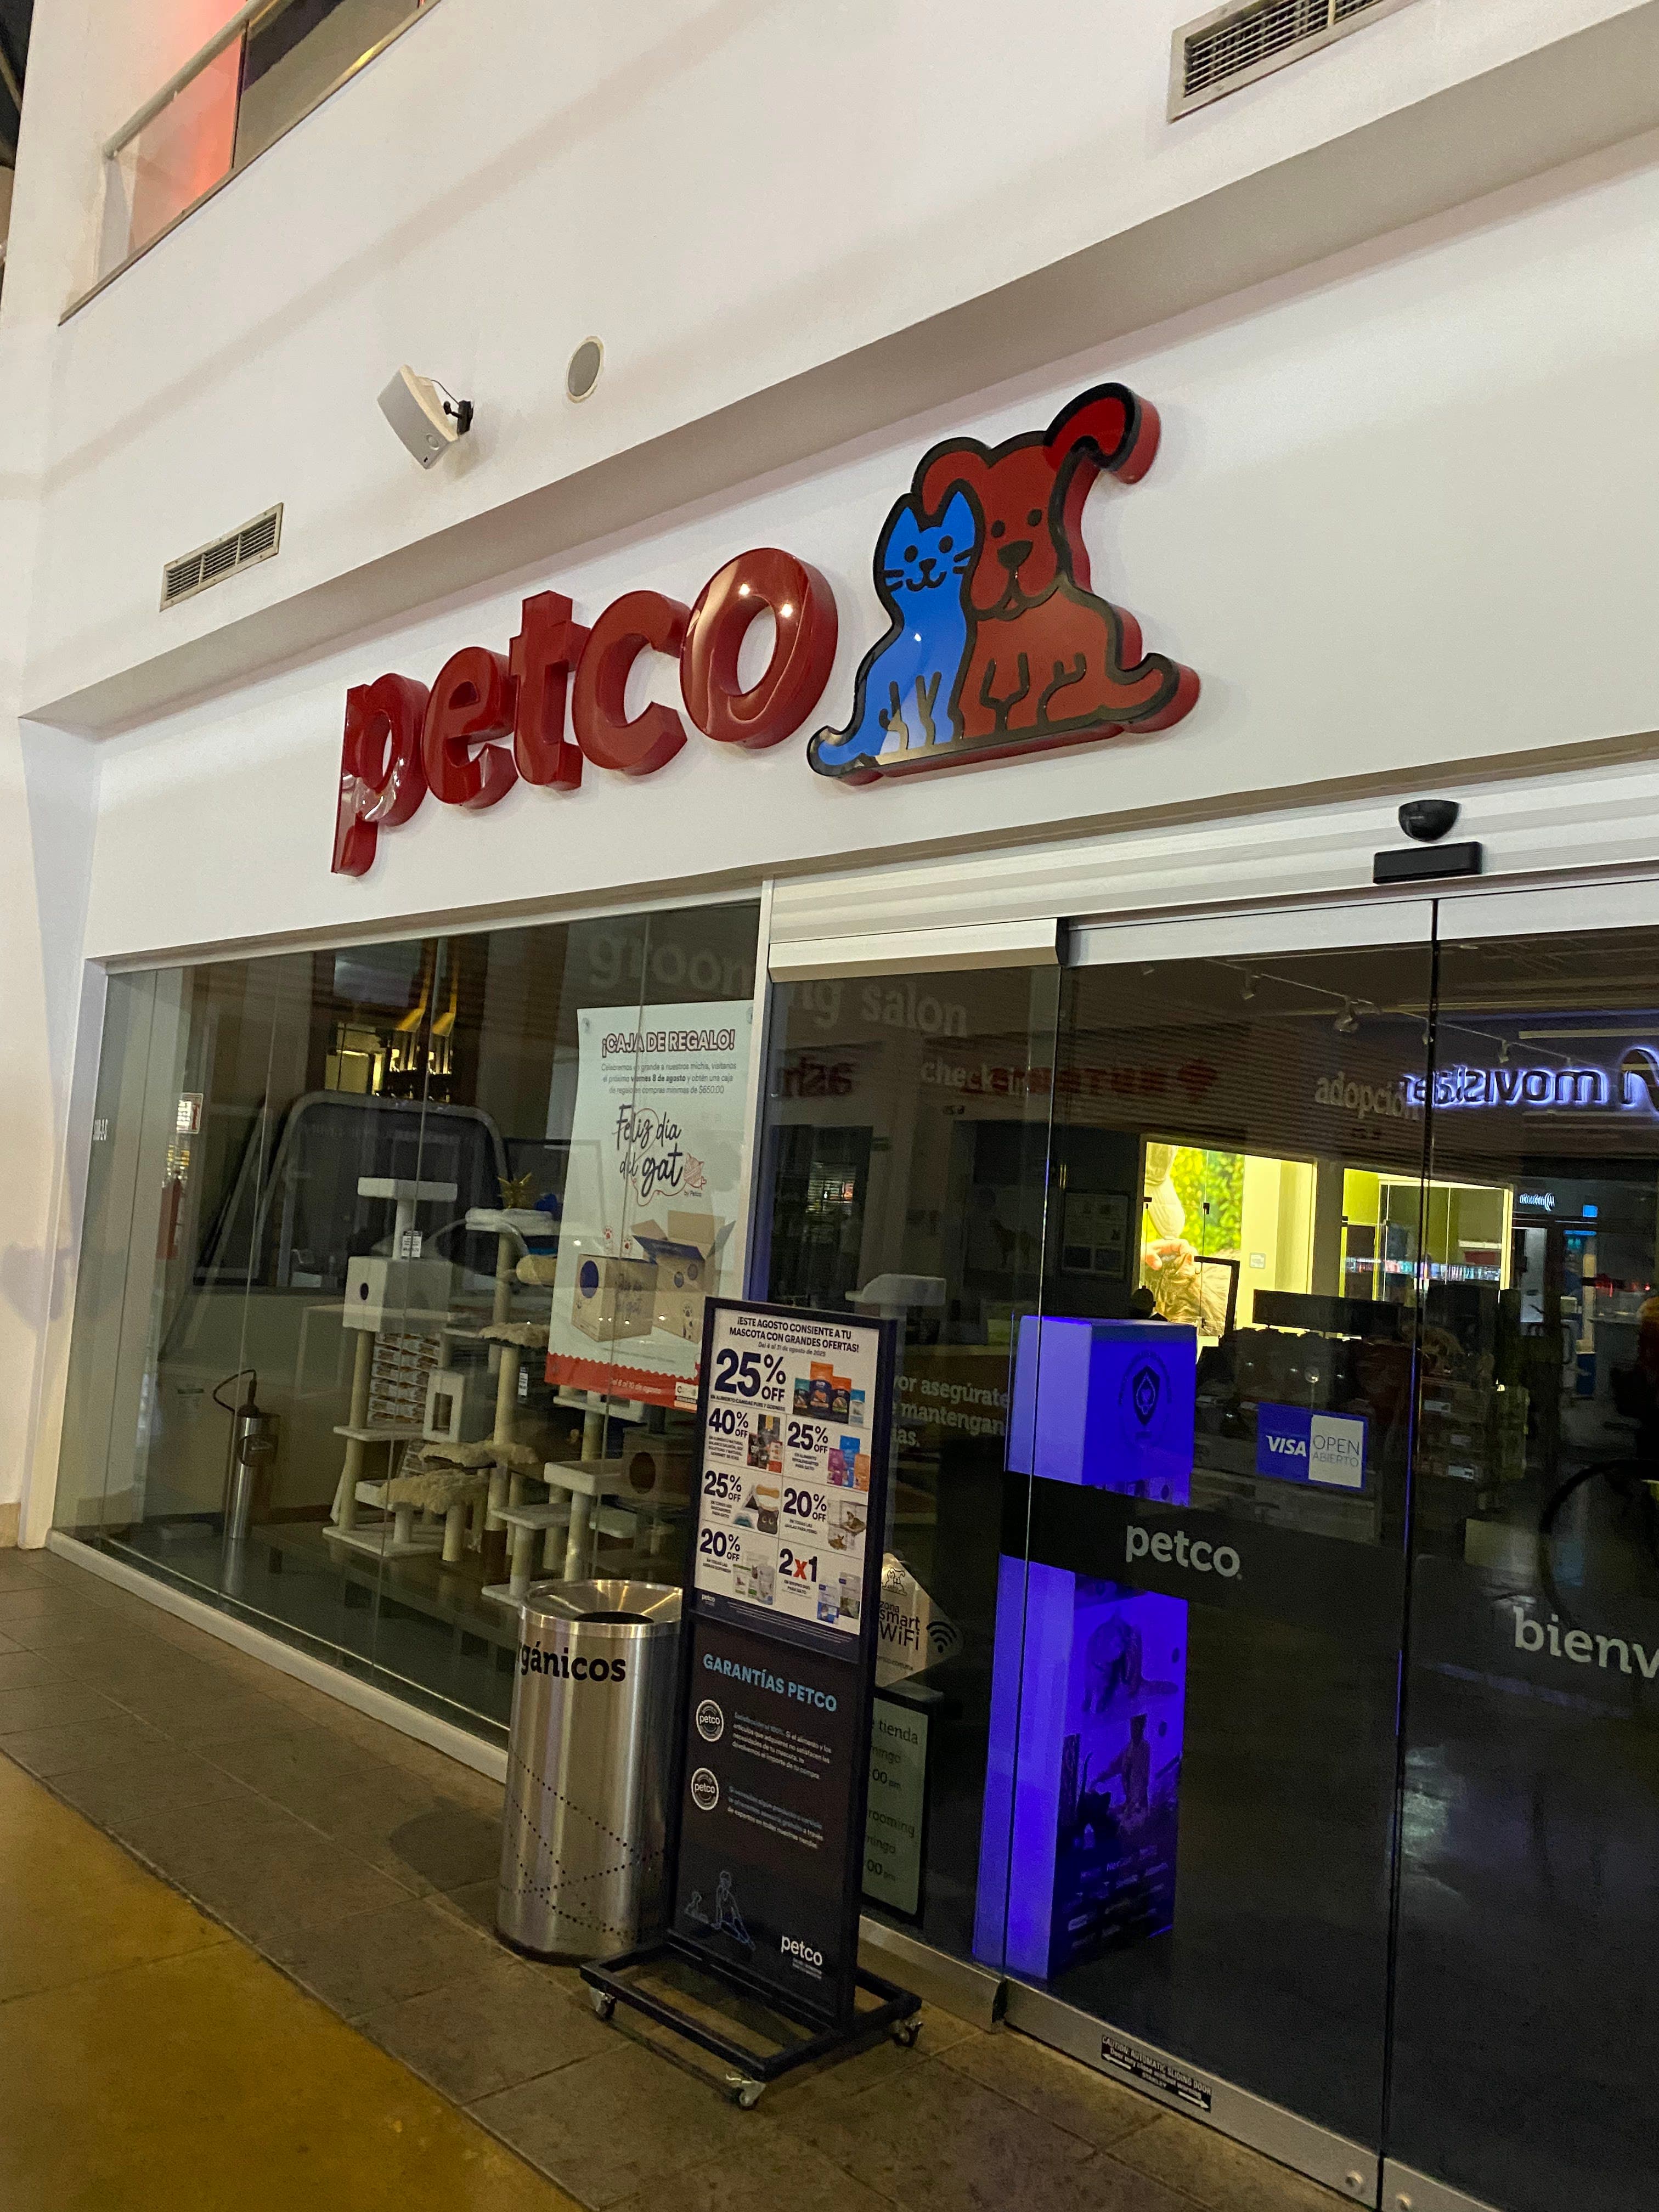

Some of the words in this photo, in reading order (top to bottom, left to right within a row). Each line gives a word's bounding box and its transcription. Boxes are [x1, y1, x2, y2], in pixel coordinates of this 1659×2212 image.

[331, 547, 839, 876] petco
[861, 981, 967, 1036] salon
[602, 1032, 646, 1058] ¡CAJA
[646, 1031, 667, 1052] DE
[668, 1029, 736, 1052] REGALO!
[665, 1075, 686, 1084] agosto
[729, 1327, 766, 1339] MASCOTA
[766, 1331, 784, 1342] CON
[785, 1334, 821, 1348] GRANDES
[822, 1339, 859, 1353] OFERTAS!
[737, 1317, 757, 1327] ¡ESTE
[757, 1319, 788, 1331] AGOSTO
[790, 1323, 834, 1338] CONSIENTE
[834, 1329, 841, 1338] A
[841, 1329, 851, 1340] TU
[714, 1348, 786, 1397] 25%
[761, 1386, 786, 1402] OFF
[921, 1378, 1010, 1408] asegúrate
[709, 1408, 749, 1435] 40%
[900, 1402, 1006, 1437] mantengan
[735, 1429, 748, 1438] OFF
[787, 1421, 828, 1451] 25%
[1265, 1435, 1307, 1457] VISA
[1313, 1435, 1360, 1456] OPEN
[814, 1444, 828, 1454] OFF
[1312, 1452, 1359, 1467] ABIERTO
[703, 1470, 742, 1498] 25%
[728, 1492, 741, 1502] OFF
[783, 1487, 827, 1517] 20%
[812, 1511, 826, 1522] OFF
[699, 1528, 741, 1558] 20%
[726, 1551, 740, 1562] OFF
[1126, 1524, 1241, 1578] petco
[778, 1548, 818, 1582] 2x1
[879, 1601, 900, 1613] zona
[879, 1609, 921, 1632] smart
[879, 1621, 919, 1651] WiFi
[1513, 1605, 1659, 1679] bienv
[703, 1653, 785, 1695] GARANTÍAS
[787, 1680, 838, 1713] PETCO
[699, 1715, 720, 1725] petco
[879, 1719, 918, 1745] tienda
[694, 1782, 715, 1794] petco
[781, 1935, 823, 1967] petco
[1131, 2050, 1166, 2074] AUTOMATIC
[1193, 2079, 1212, 2095] DOOR
